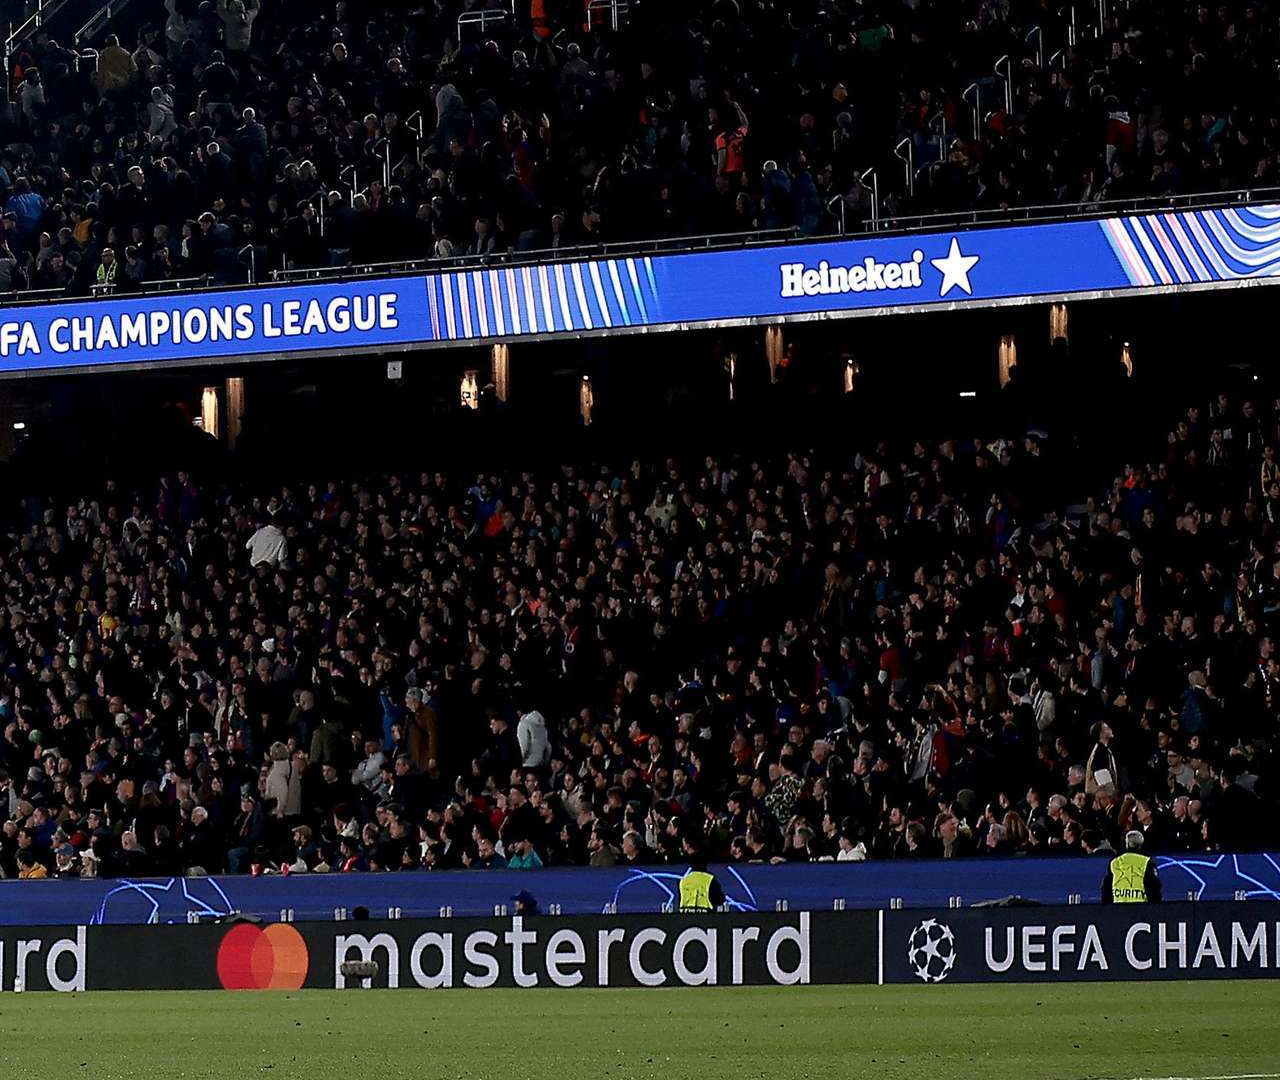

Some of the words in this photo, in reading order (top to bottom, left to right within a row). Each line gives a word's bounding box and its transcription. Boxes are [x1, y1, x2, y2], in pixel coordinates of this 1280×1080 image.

[781, 254, 922, 297] Heineken
[48, 305, 254, 352] CHAMPIONS
[263, 294, 398, 336] LEAGUE
[1112, 888, 1147, 899] CURITY
[335, 912, 811, 989] mastercard
[985, 924, 1109, 972] UEFA
